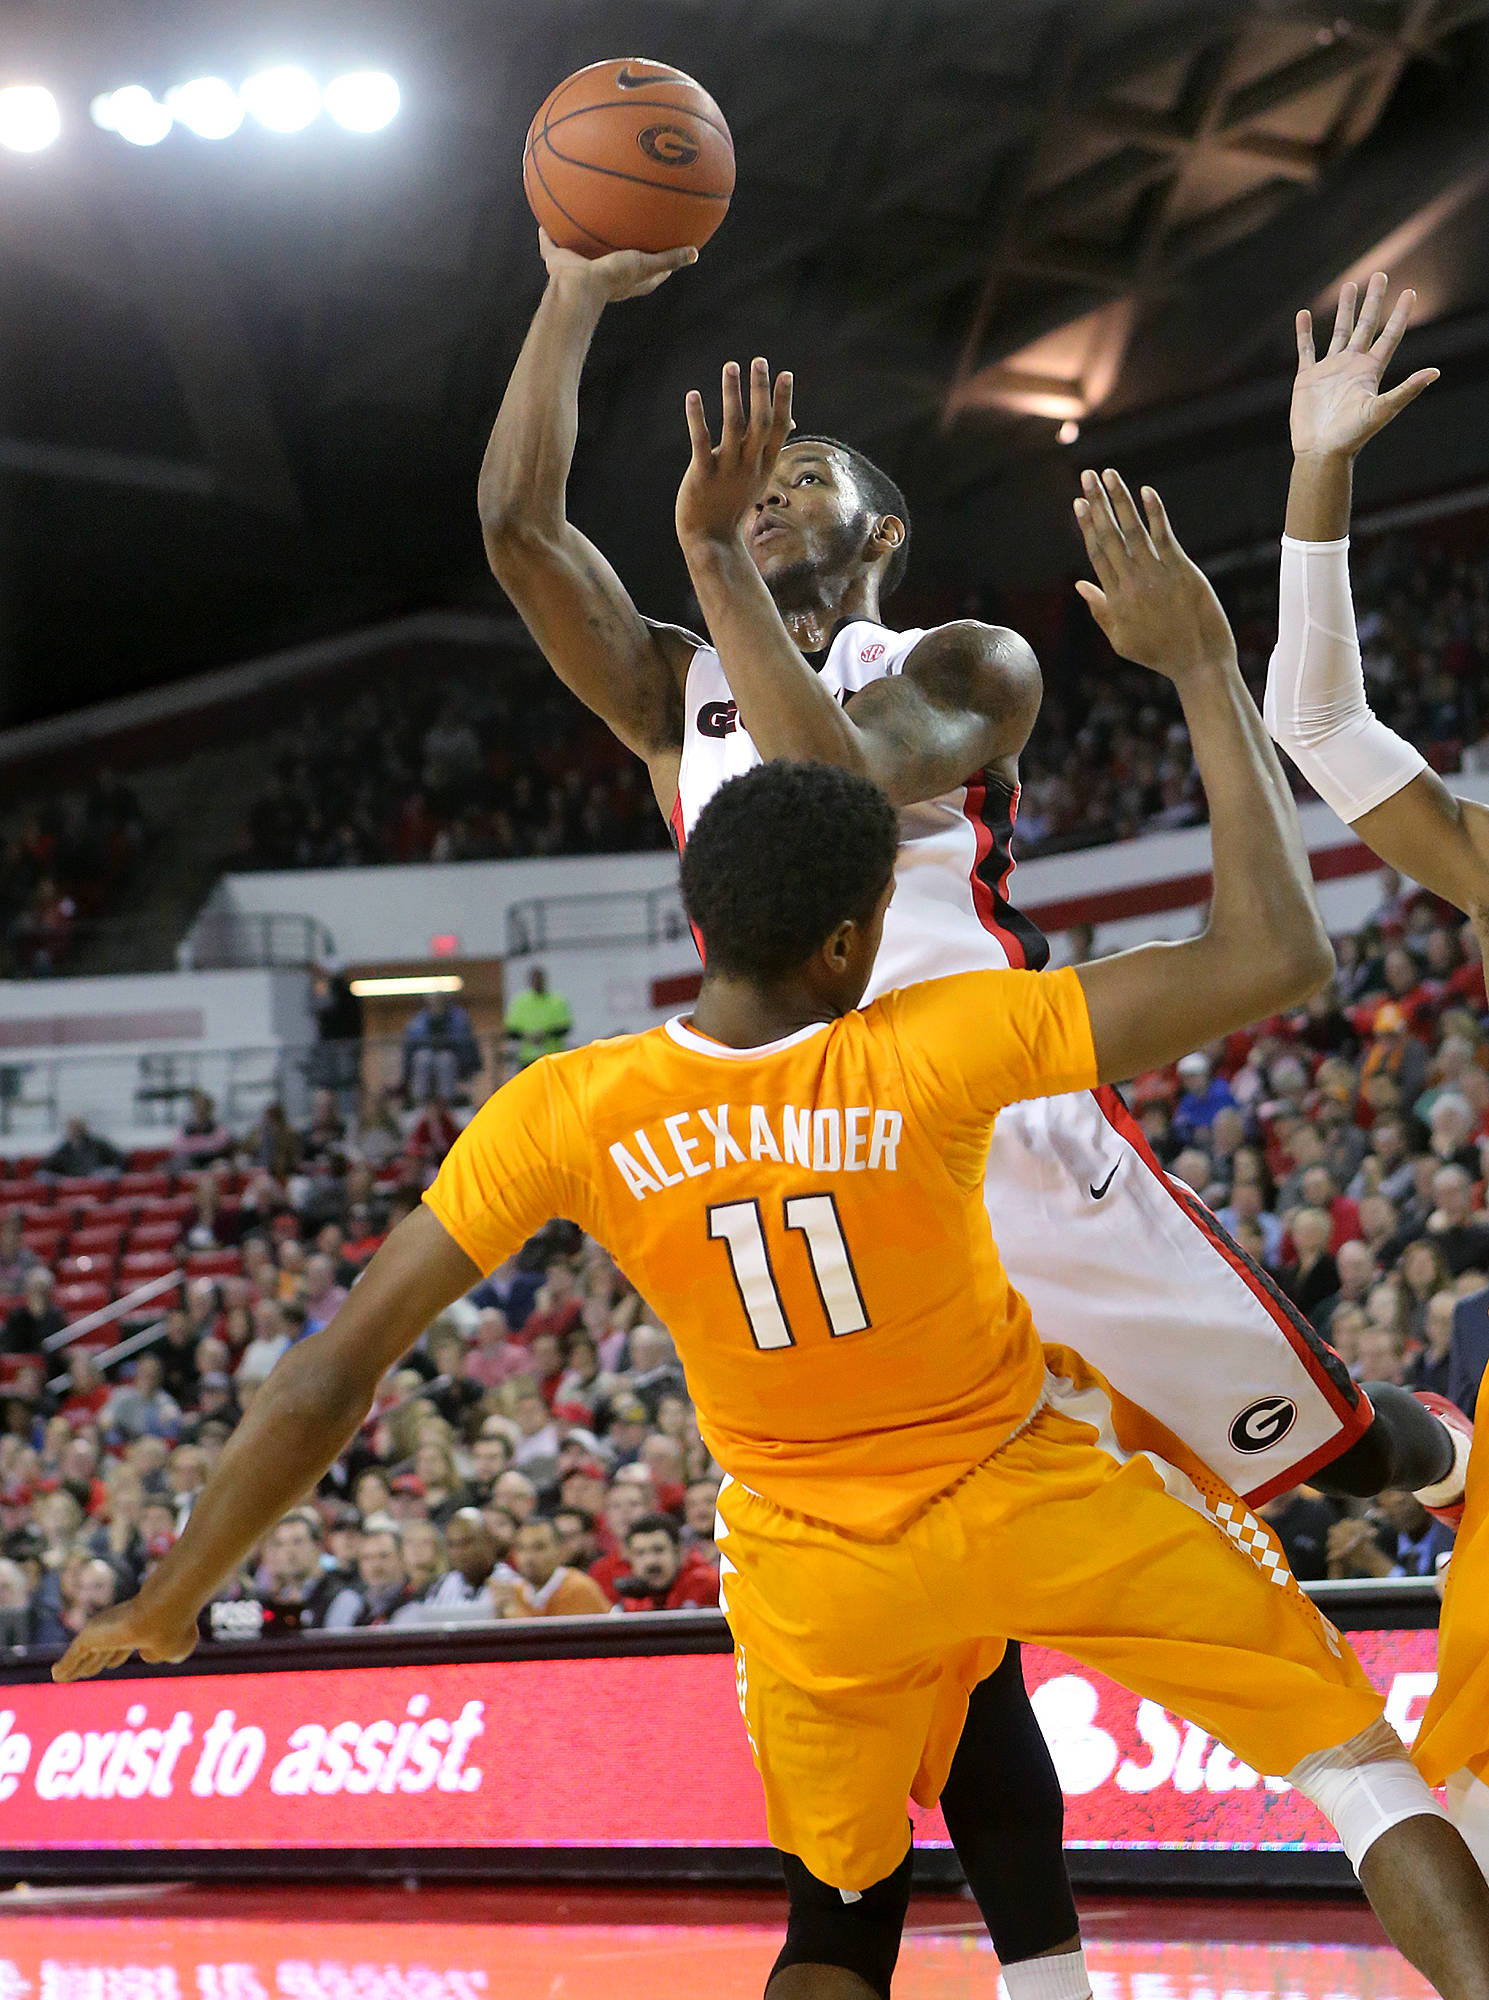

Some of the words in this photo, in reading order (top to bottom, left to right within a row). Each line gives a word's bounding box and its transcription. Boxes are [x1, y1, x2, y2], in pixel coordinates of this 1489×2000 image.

[638, 124, 699, 166] G
[861, 644, 885, 662] SEC
[608, 1103, 903, 1201] ALEXANDER
[706, 1192, 872, 1351] 11
[1229, 1397, 1297, 1454] G
[0, 1710, 31, 1800] e
[35, 1704, 194, 1800] exist
[191, 1709, 267, 1797] to
[270, 1694, 486, 1795] assist.
[1115, 1697, 1293, 1794] Sta
